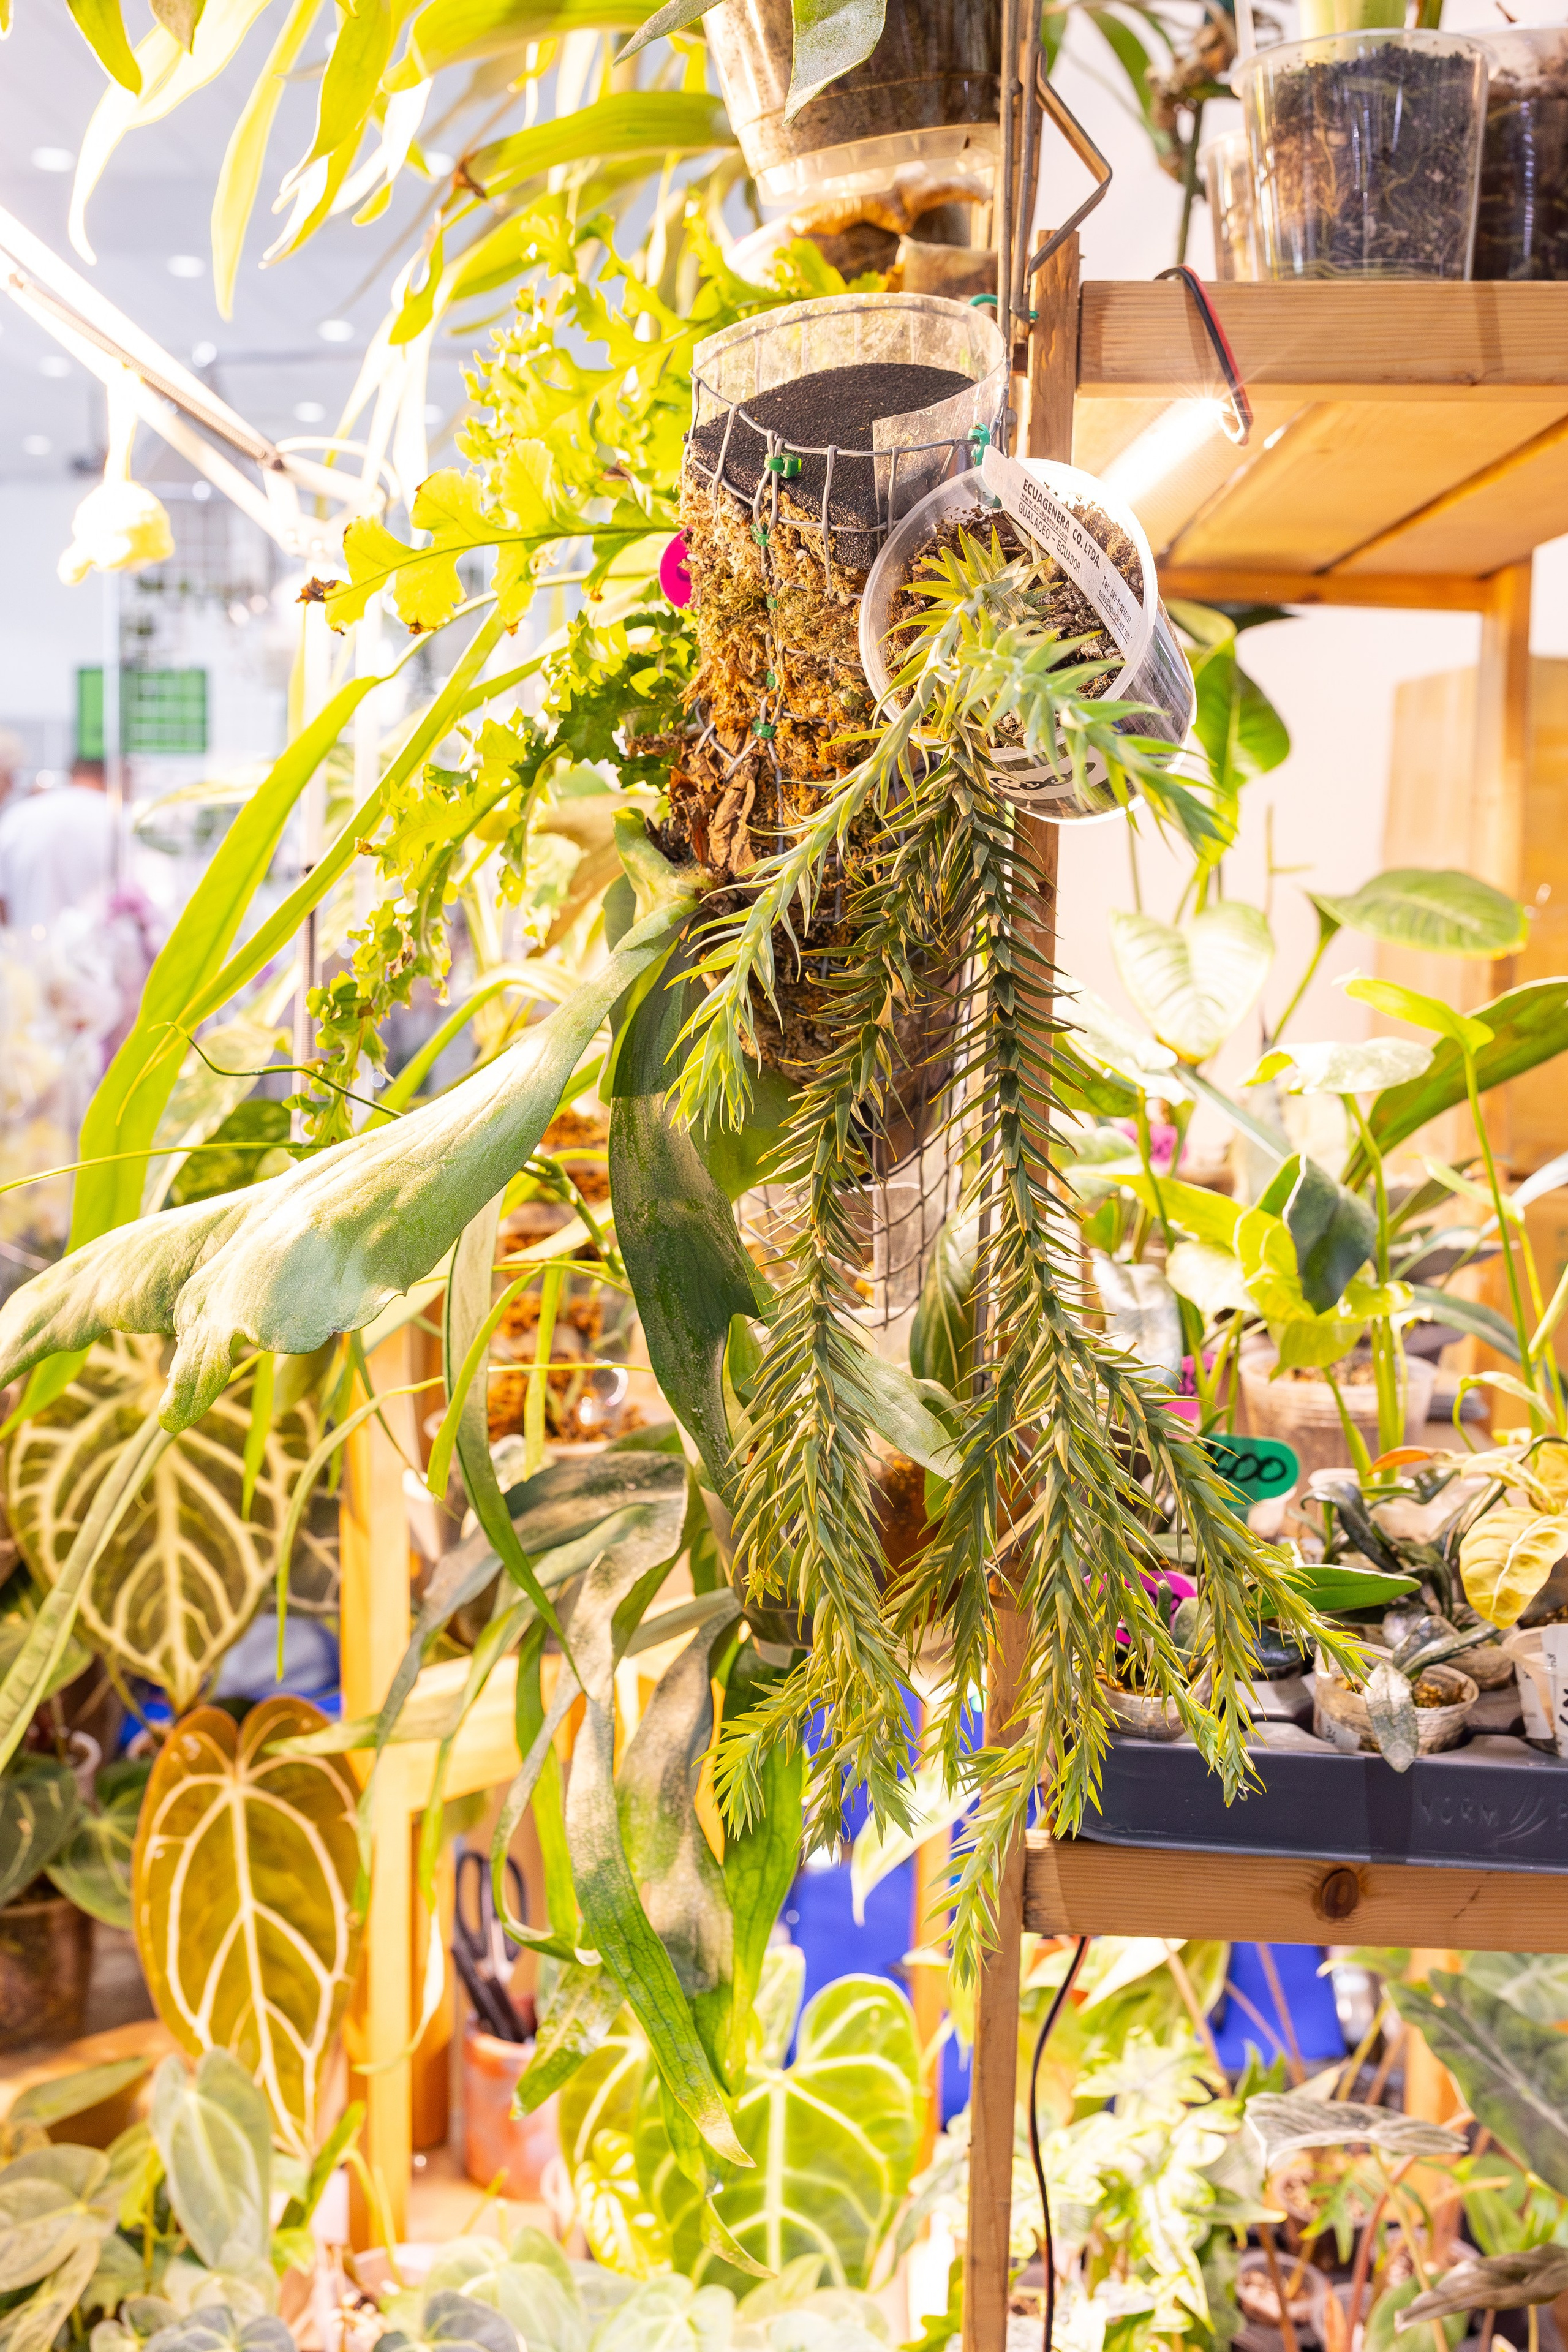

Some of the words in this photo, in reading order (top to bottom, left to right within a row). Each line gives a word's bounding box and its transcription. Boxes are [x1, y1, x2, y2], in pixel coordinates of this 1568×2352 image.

[1019, 502, 1050, 540] GUALACEO
[1057, 540, 1081, 573] ECUADOR
[1021, 492, 1069, 541] www.ecuagenera.com
[1023, 478, 1070, 533] ECUAGENERA
[1072, 529, 1082, 548] CO.
[1084, 541, 1100, 569] LTDA.
